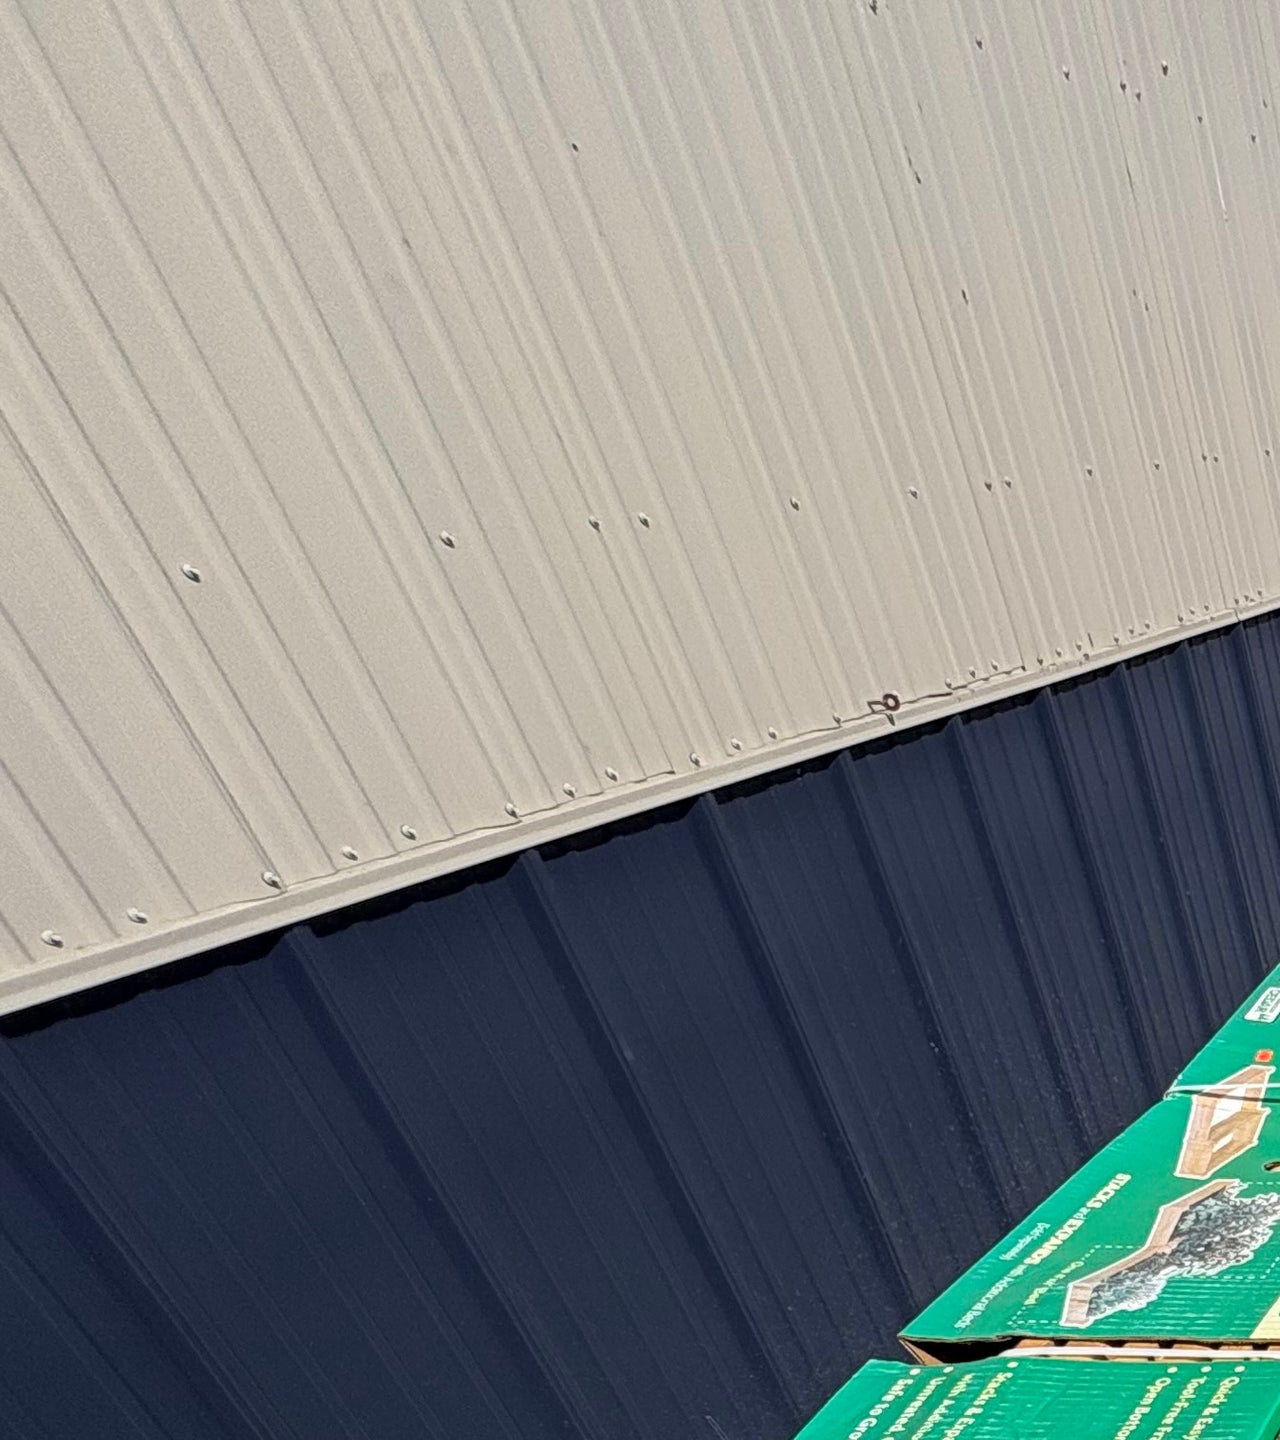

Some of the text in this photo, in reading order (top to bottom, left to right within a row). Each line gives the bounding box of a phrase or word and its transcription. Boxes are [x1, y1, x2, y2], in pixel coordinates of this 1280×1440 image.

[880, 1377, 914, 1402] Safe
[948, 1372, 976, 1397] with
[971, 1372, 1014, 1407] Stacks
[1141, 1376, 1172, 1406] Open
[1208, 1376, 1241, 1408] Quick
[869, 1402, 890, 1417] to
[968, 1406, 985, 1416] &
[1158, 1375, 1207, 1427] Tool-Free
[1204, 1407, 1221, 1418] &
